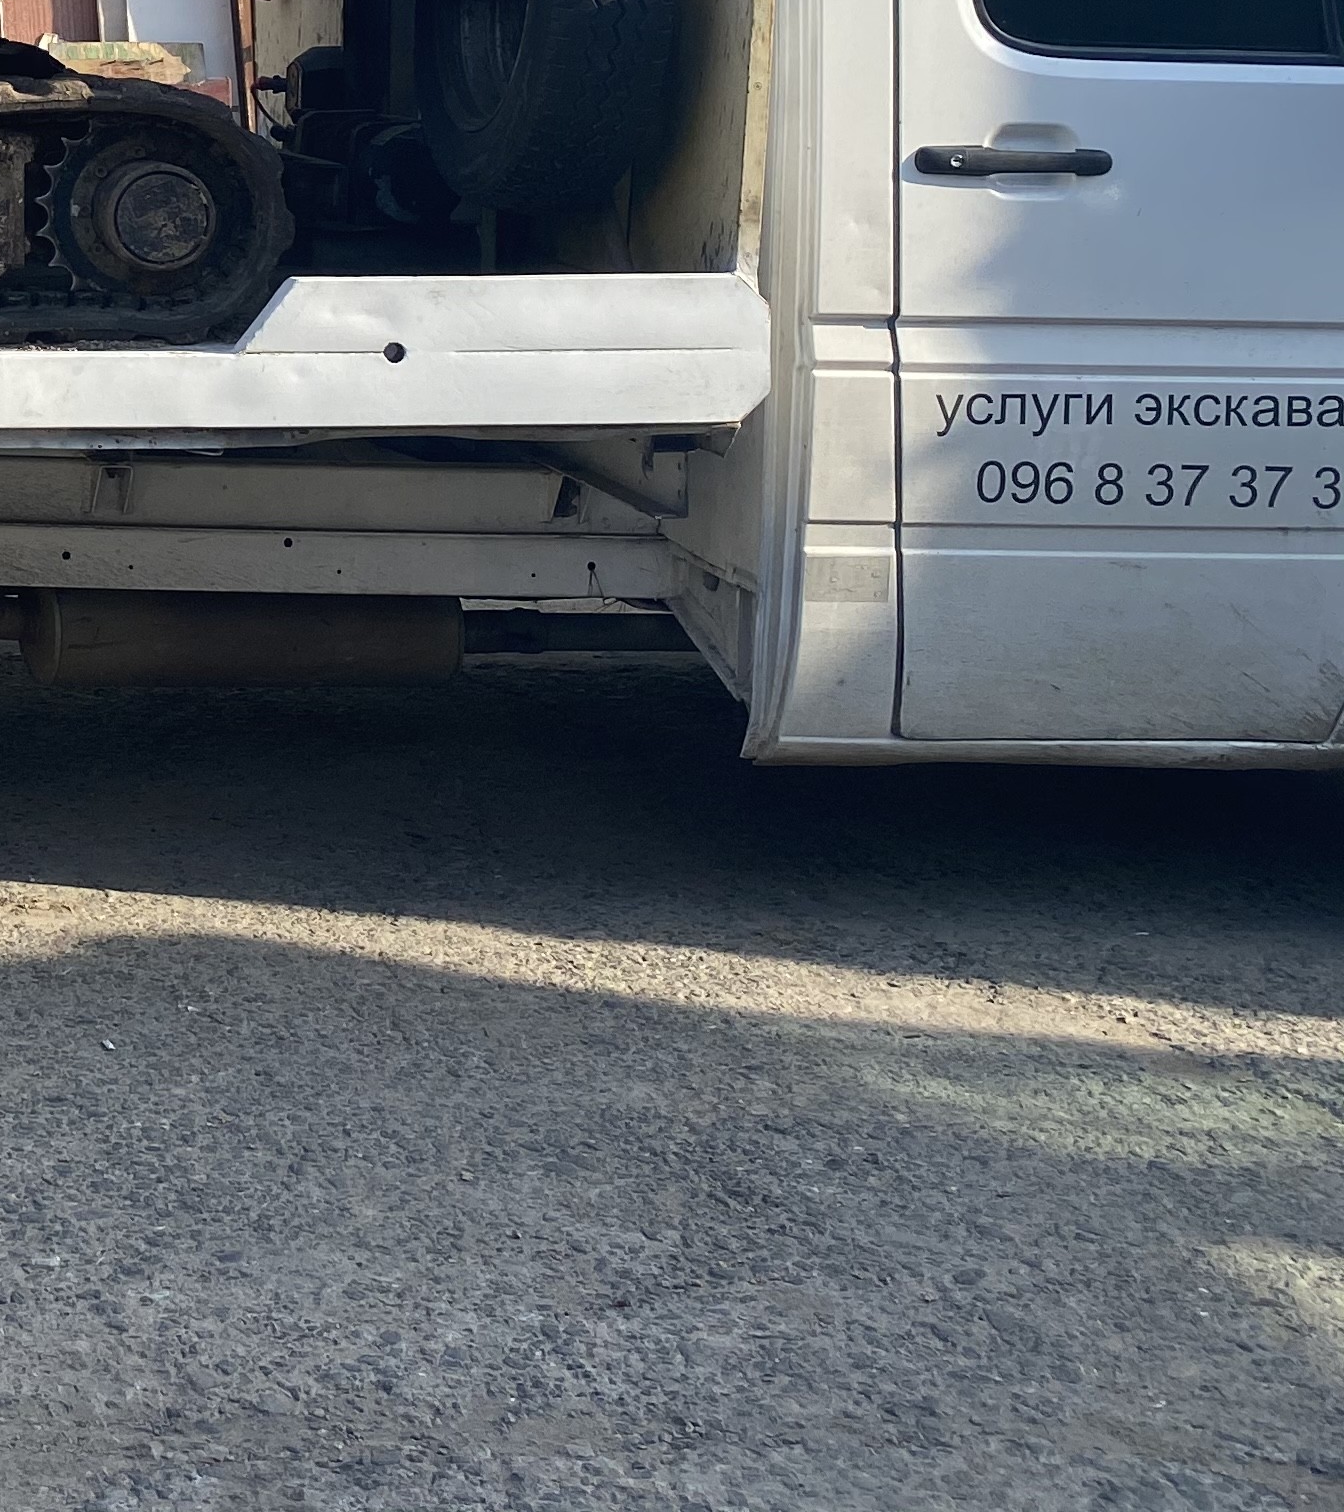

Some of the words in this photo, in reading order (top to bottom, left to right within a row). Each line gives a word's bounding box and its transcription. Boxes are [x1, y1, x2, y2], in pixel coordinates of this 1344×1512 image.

[936, 393, 1114, 436] услуги
[1134, 394, 1344, 427] экскава
[977, 460, 1074, 504] 096
[1094, 462, 1124, 506] 8
[1145, 464, 1210, 507] 37
[1229, 465, 1293, 509] 37
[1312, 467, 1342, 509] 3
